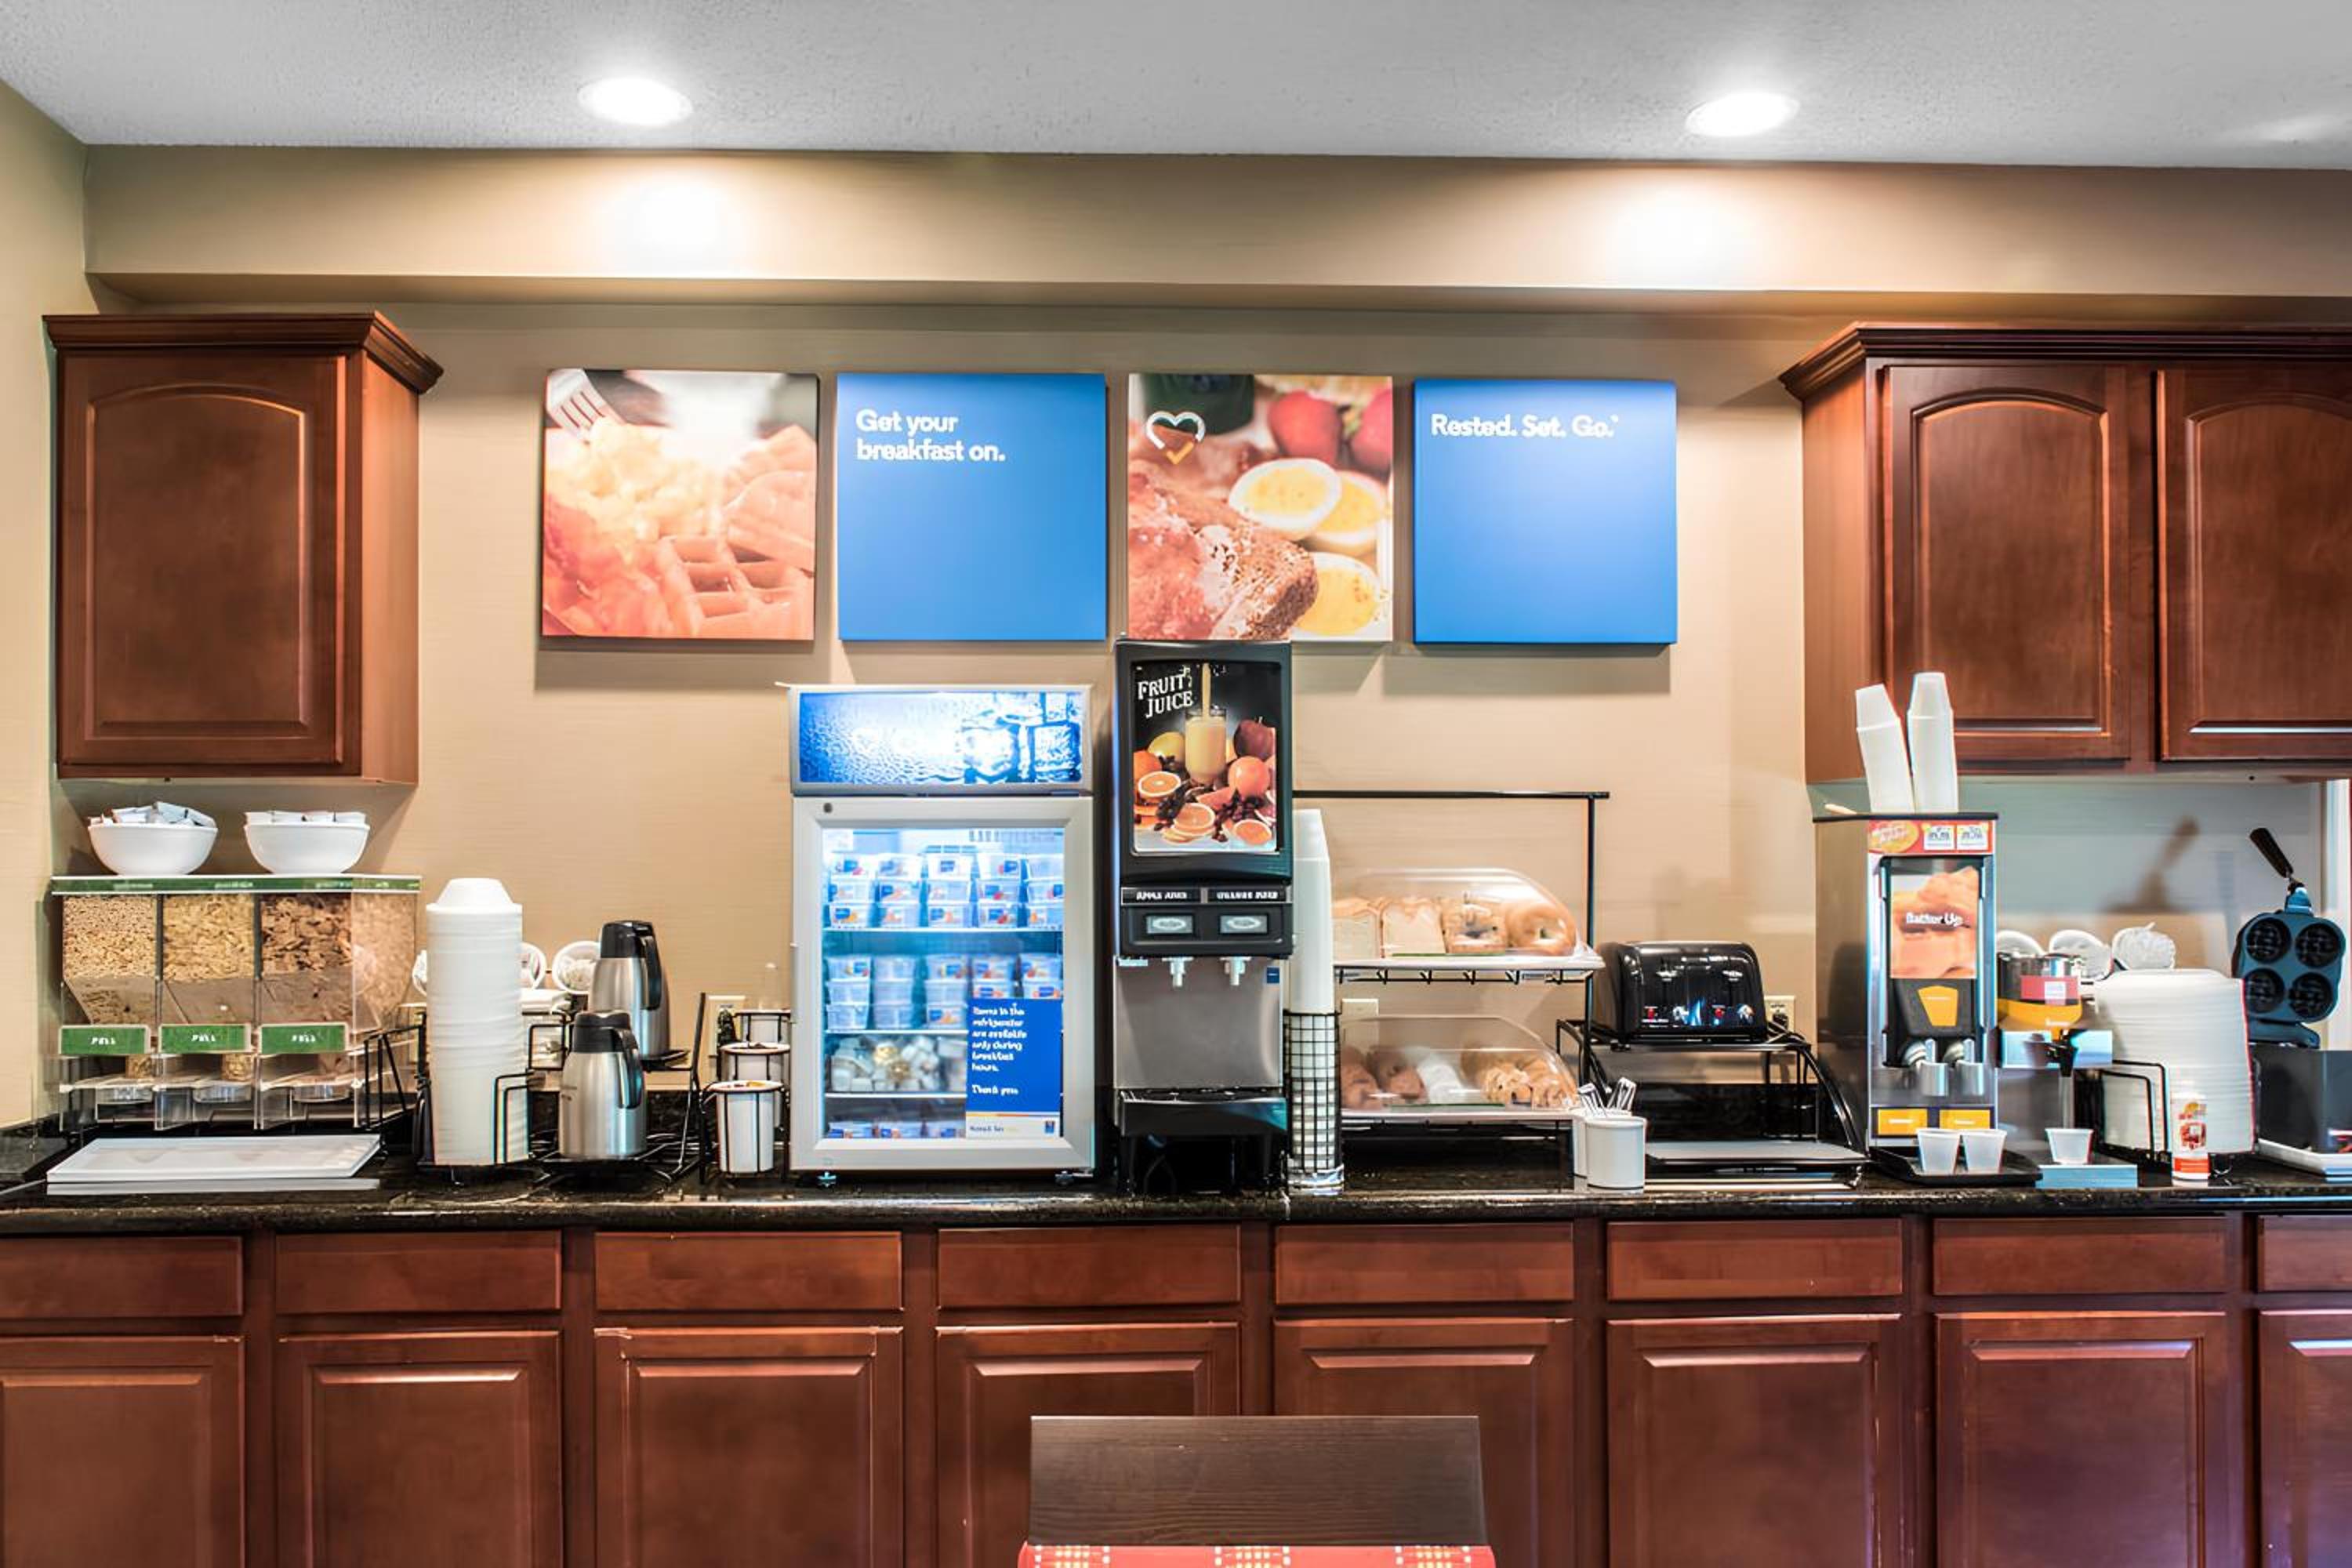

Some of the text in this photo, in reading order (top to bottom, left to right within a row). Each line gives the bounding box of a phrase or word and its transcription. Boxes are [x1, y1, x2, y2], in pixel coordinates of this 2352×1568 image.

[856, 408, 959, 437] Get your
[1431, 414, 1517, 437] Rested.
[1522, 415, 1567, 438] Set.
[857, 438, 1007, 461] breakfast on.
[1138, 673, 1185, 700] FRUIT
[1145, 691, 1194, 718] JUICE
[1906, 912, 1943, 924] Batter
